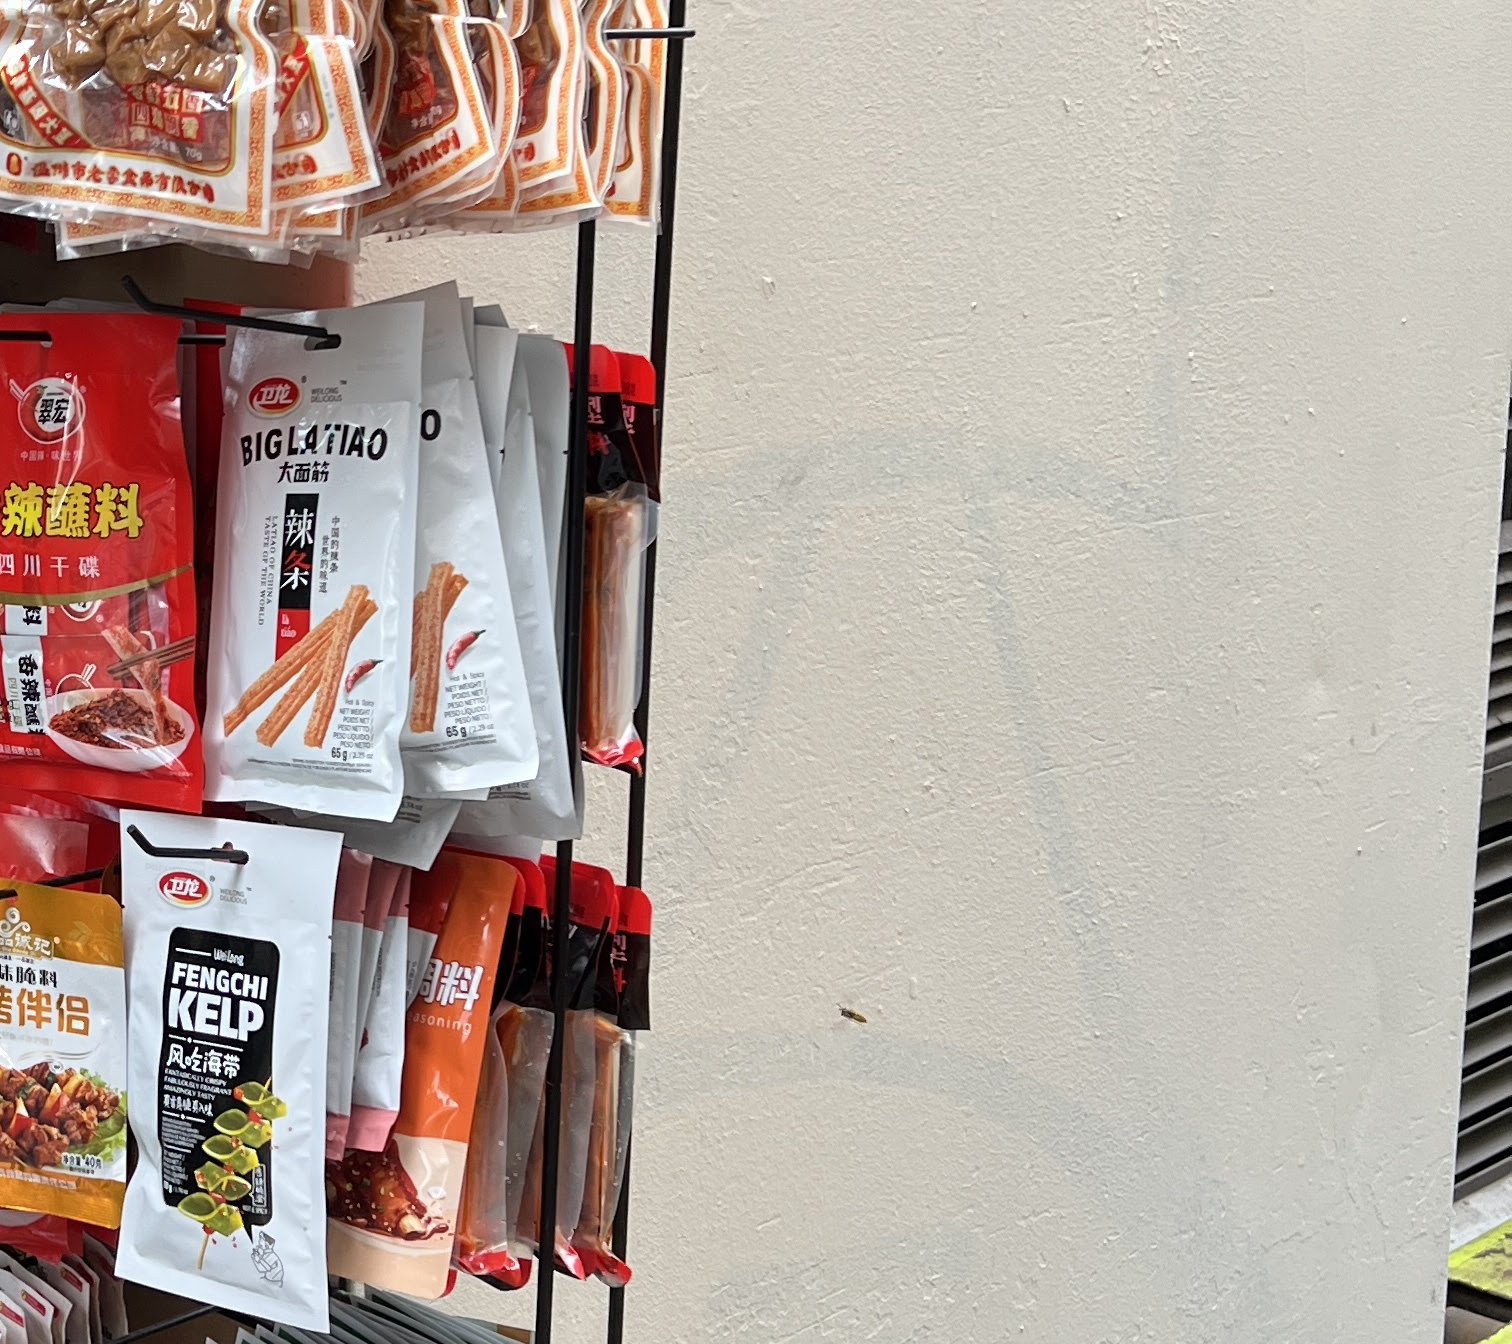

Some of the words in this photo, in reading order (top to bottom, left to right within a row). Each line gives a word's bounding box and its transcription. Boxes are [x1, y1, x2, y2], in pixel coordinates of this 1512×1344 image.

[240, 432, 283, 467] BIG
[287, 422, 390, 462] LATIAO
[277, 461, 330, 484] 大面筋
[281, 507, 318, 591] 辣条
[171, 961, 269, 1000] FENGCHI
[168, 995, 266, 1042] KELP
[408, 1011, 473, 1035] easoning
[166, 1042, 242, 1078] 风吃海带
